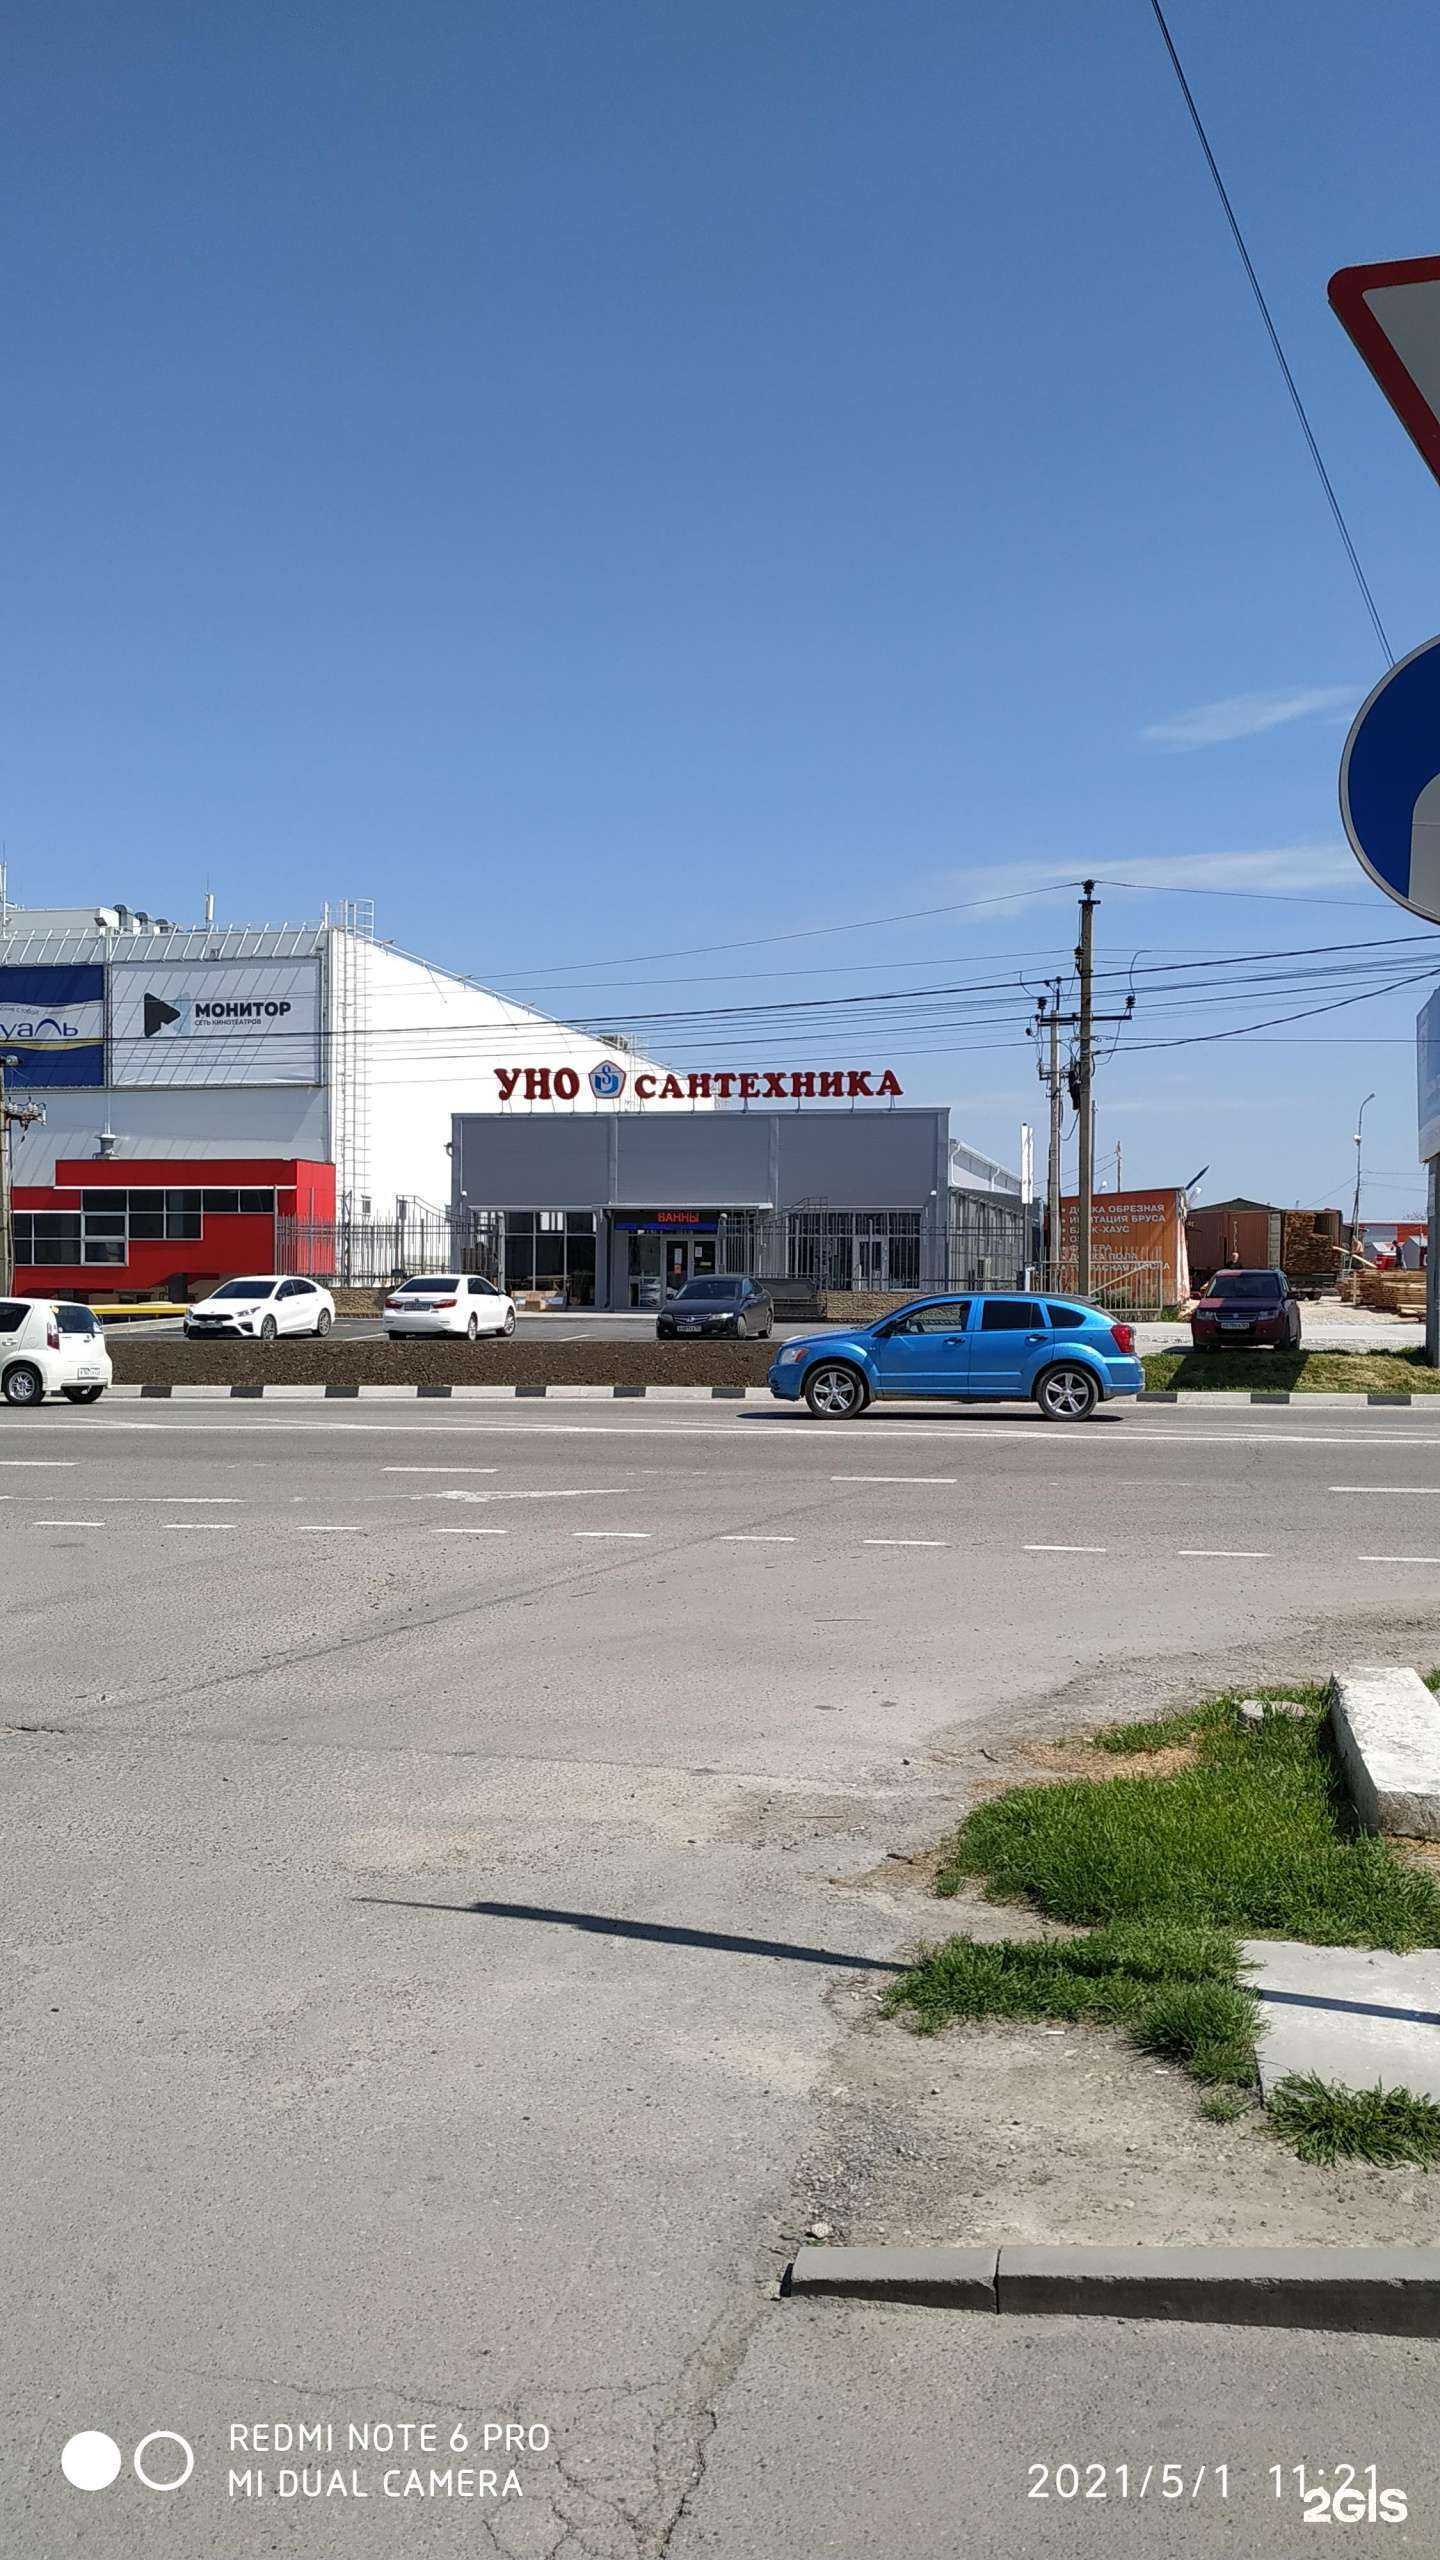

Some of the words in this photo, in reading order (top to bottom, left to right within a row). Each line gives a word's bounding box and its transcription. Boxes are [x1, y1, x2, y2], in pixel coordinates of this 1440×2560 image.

[195, 1001, 292, 1018] МОНИТОР
[493, 1067, 580, 1100] УНО
[634, 1069, 904, 1099] САНТЕХНИКА
[1108, 1204, 1165, 1213] ОБРЕЗНАЯ
[657, 1212, 700, 1223] ВАННЫ
[1069, 1215, 1128, 1224] ИТАЦИЯ
[1131, 1214, 1166, 1223] БРУСА
[1069, 1225, 1130, 1234] БК-ХАУС
[1069, 1244, 1112, 1252] ФЕРА
